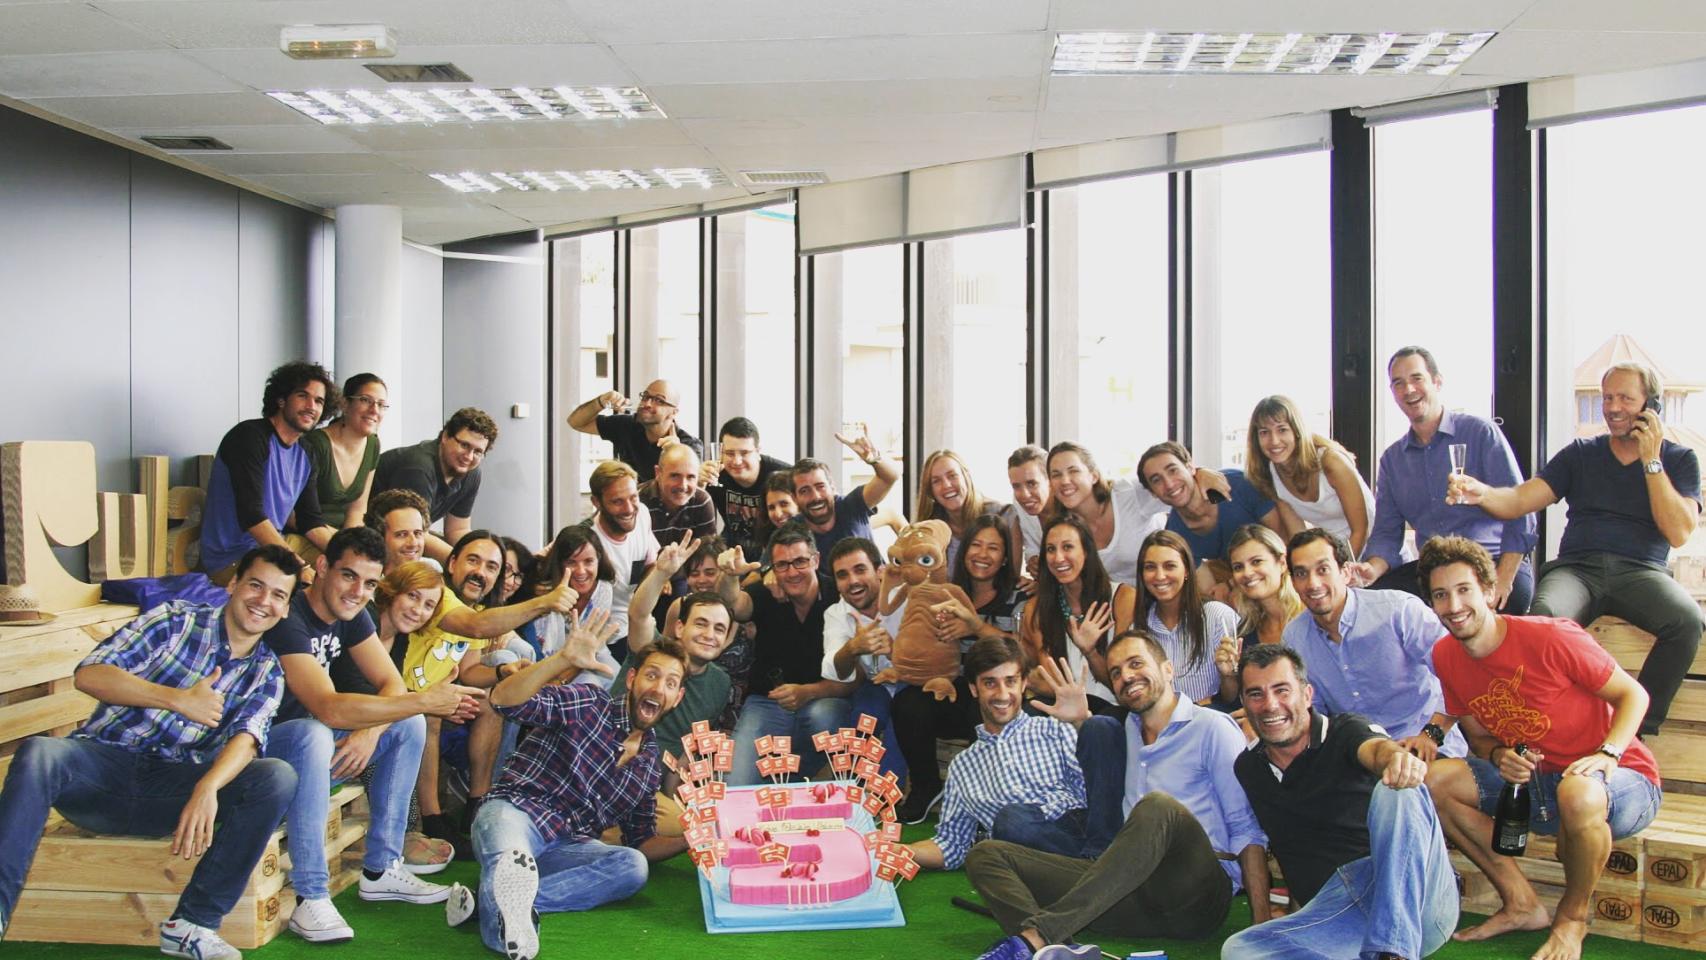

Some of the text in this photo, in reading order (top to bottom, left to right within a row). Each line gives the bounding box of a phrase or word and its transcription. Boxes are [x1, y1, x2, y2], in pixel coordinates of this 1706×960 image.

[1656, 862, 1681, 880] EPAL
[1604, 900, 1628, 918] EPAL
[1651, 908, 1675, 926] EPAL
